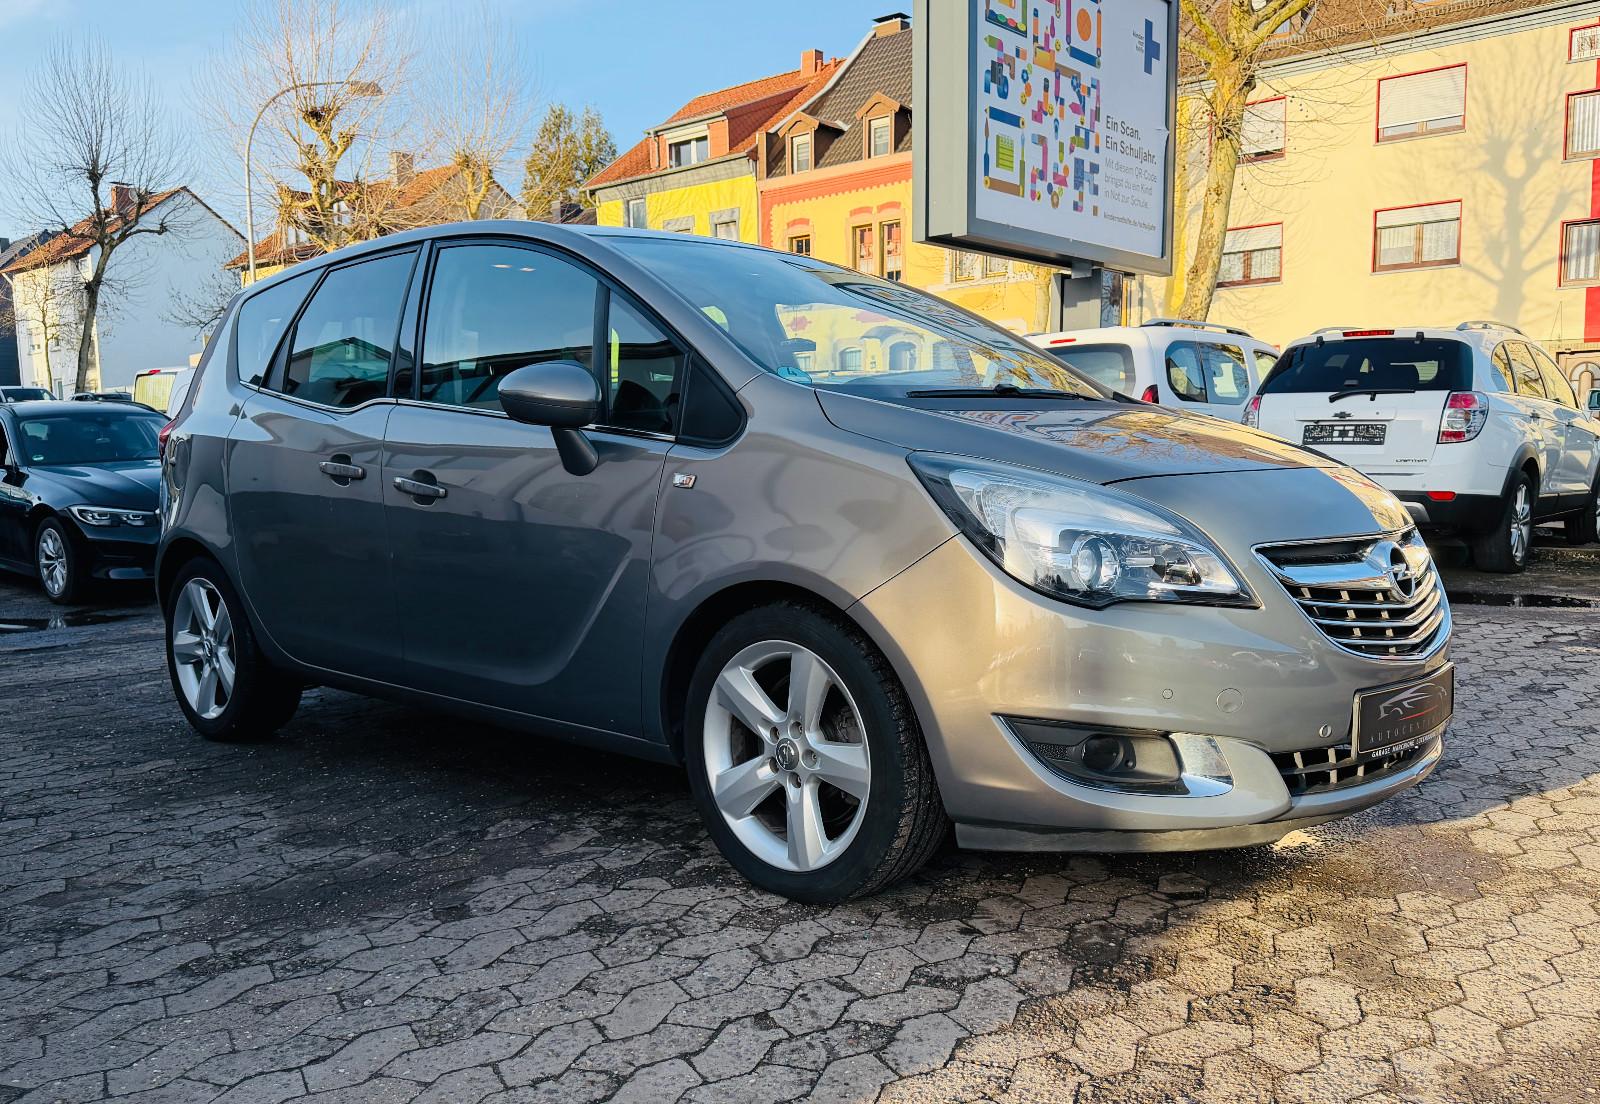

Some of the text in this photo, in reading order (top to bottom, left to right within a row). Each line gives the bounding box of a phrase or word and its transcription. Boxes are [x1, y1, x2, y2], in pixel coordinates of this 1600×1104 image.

[1106, 115, 1141, 141] Ein Scan.
[1105, 135, 1157, 165] Ein Schuljahr.
[1105, 157, 1157, 183] Mit diesem QR-Code
[1104, 173, 1153, 196] bringst du ein Kind
[1104, 188, 1110, 198] in
[1110, 189, 1121, 202] Not
[1121, 194, 1130, 203] zur
[1371, 747, 1391, 758] GARAGE
